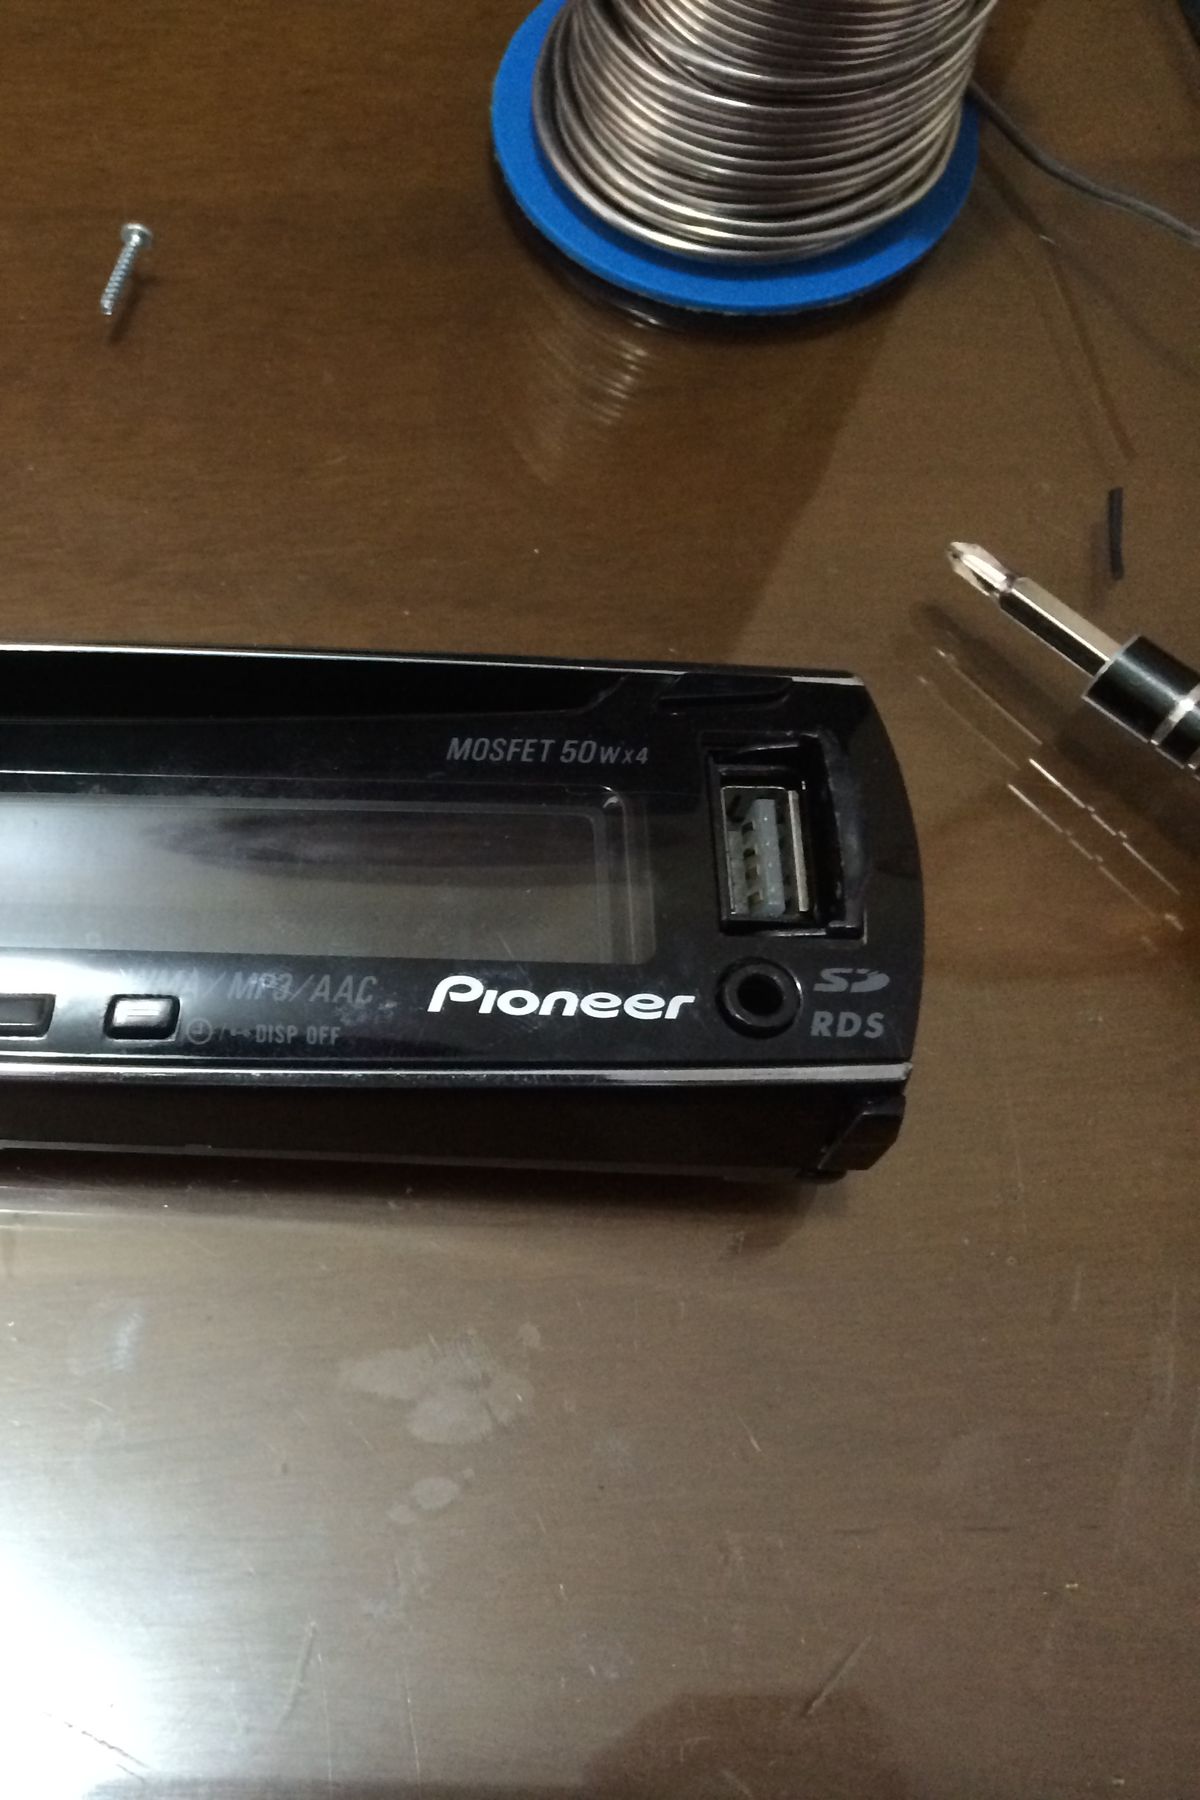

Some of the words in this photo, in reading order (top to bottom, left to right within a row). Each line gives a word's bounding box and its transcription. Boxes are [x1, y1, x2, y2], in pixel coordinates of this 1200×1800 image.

[446, 737, 556, 762] MOSFET
[813, 967, 890, 993] SD
[427, 975, 696, 1020] Pioneer
[256, 1024, 298, 1044] DISP
[306, 1026, 341, 1045] OFF
[810, 1011, 885, 1039] RDS
